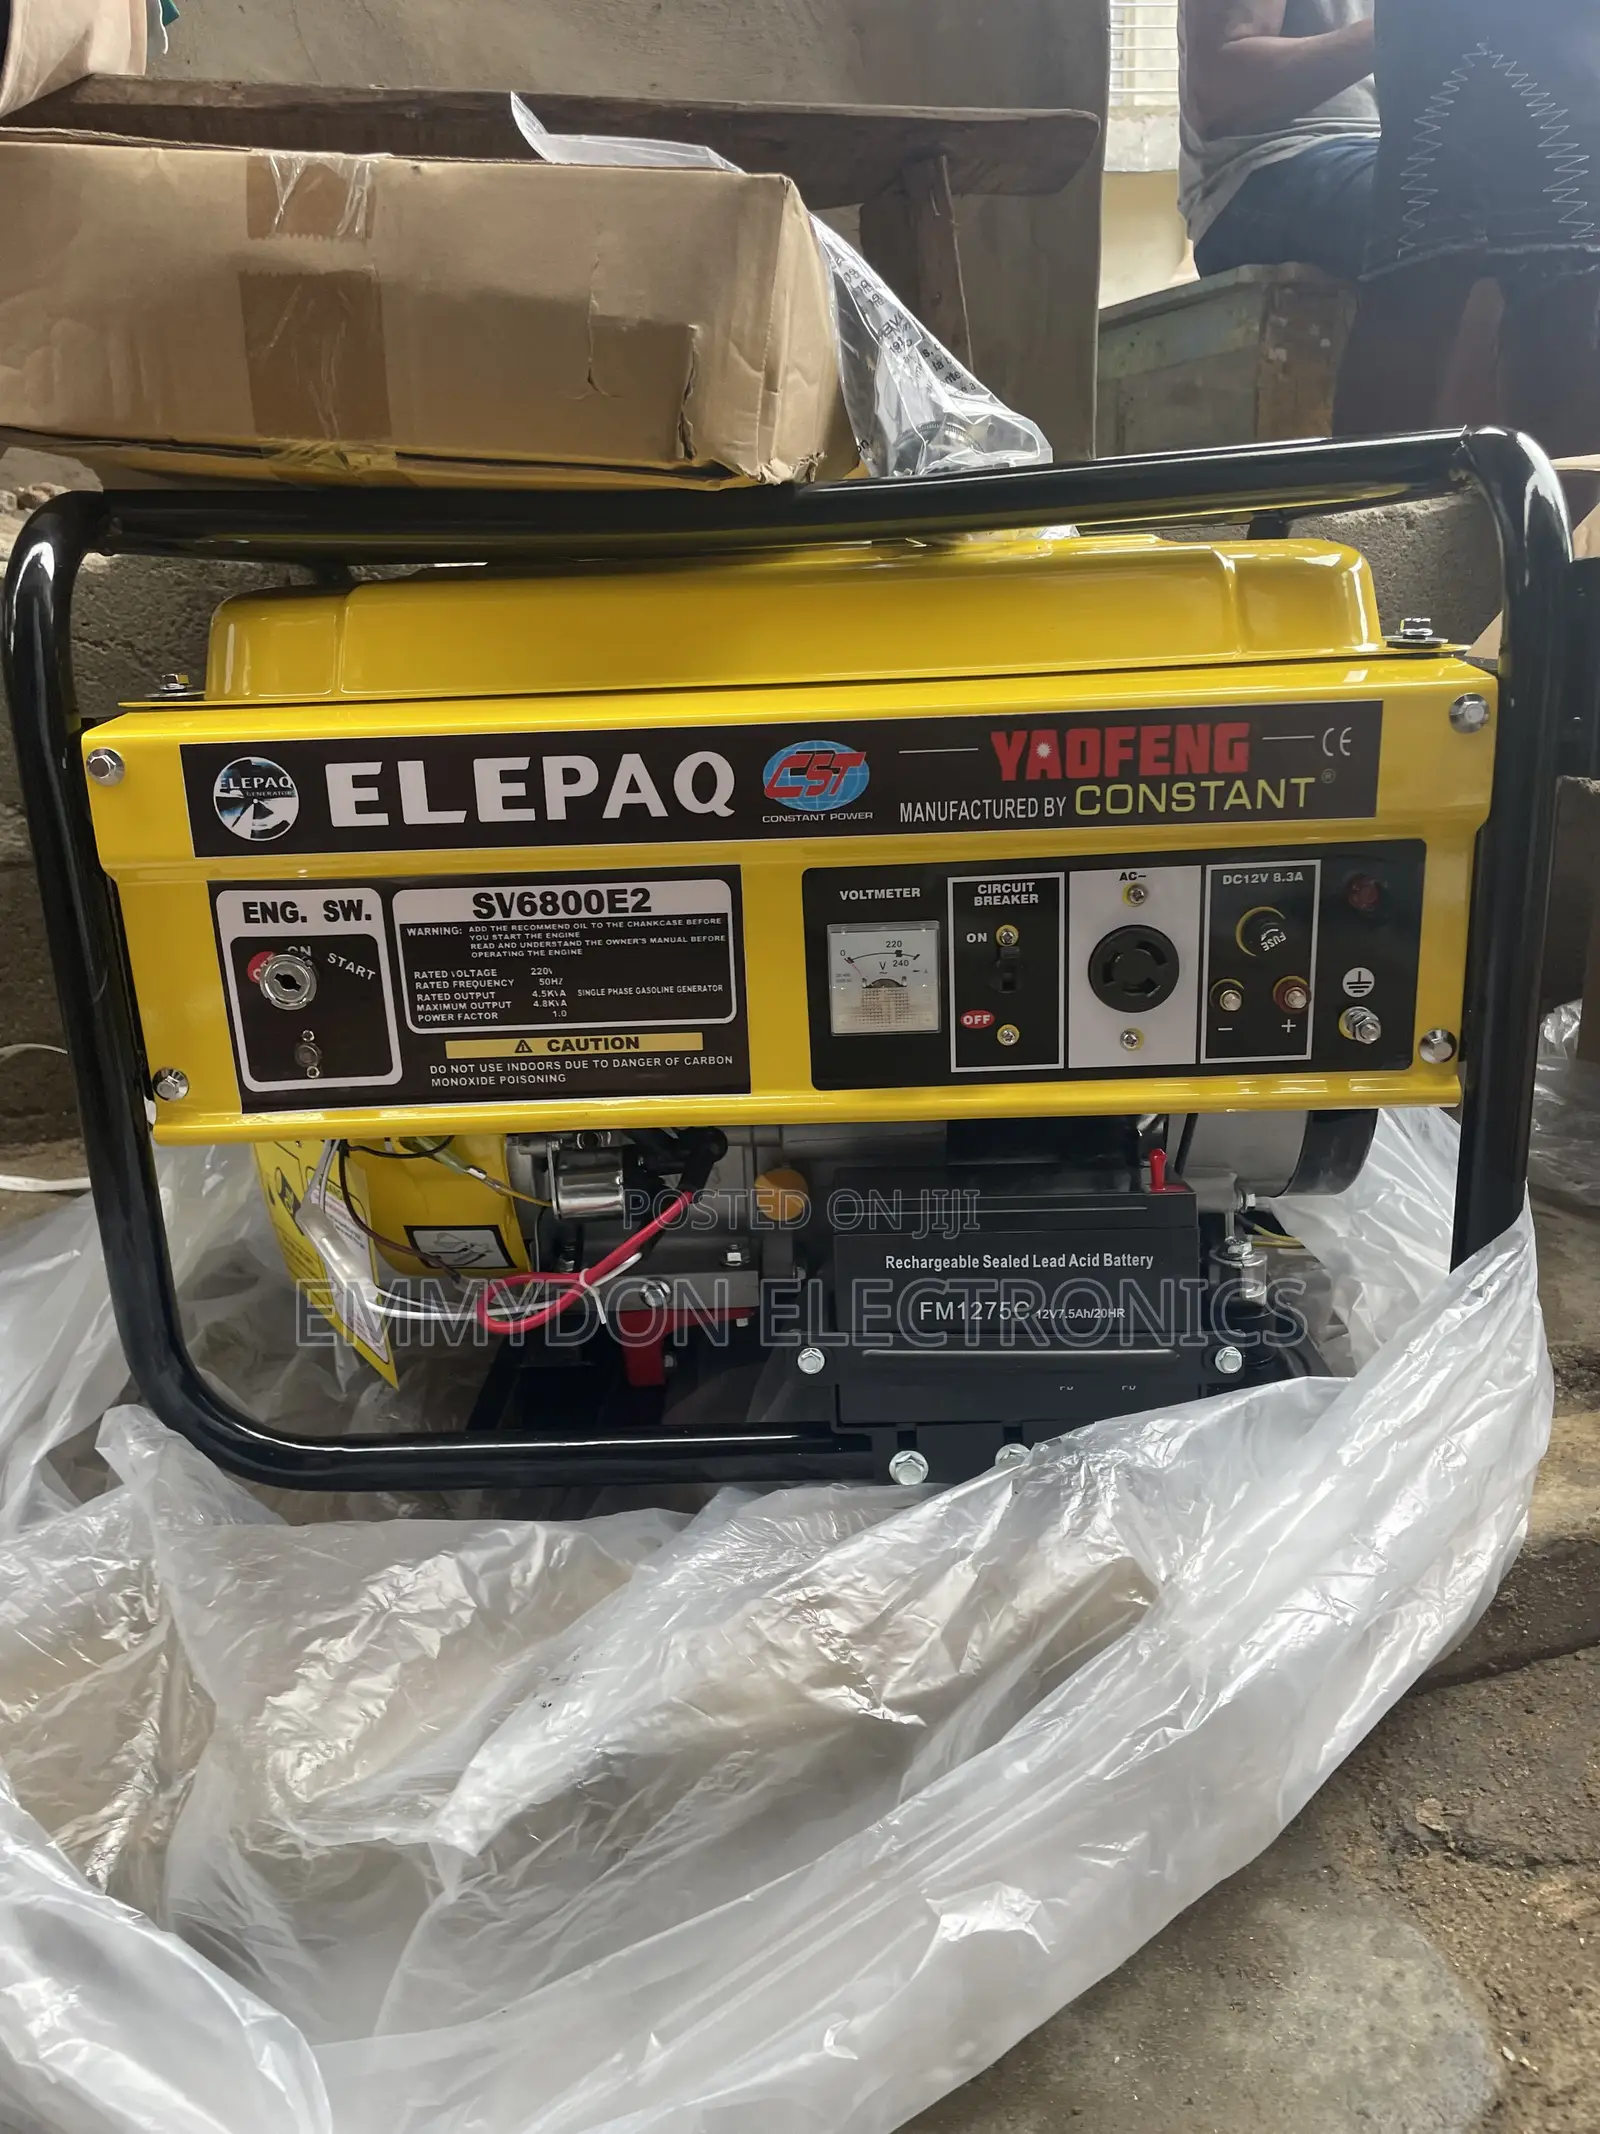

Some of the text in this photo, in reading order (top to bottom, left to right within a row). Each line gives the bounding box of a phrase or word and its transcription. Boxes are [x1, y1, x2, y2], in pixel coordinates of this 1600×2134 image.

[990, 722, 1250, 781] YAOFENG
[764, 751, 867, 799] CST
[220, 776, 292, 789] ELEPAQ
[325, 751, 735, 827] ELEPAQ
[900, 798, 1038, 823] MANUFACTURED
[1044, 796, 1067, 817] BY
[1075, 777, 1315, 816] CONSTANT
[762, 812, 873, 823] CONSTANT POWER
[1222, 871, 1304, 885] DC12V 8.3A
[839, 887, 921, 901] VOLTMETER
[977, 882, 1036, 895] CIRCUIT
[472, 888, 652, 920] SV6800E2
[974, 893, 1039, 907] BREAKER
[242, 899, 372, 924] ENG. SW.
[406, 925, 463, 937] WARNING:
[469, 925, 488, 933] ADD
[511, 923, 570, 932] RECOMMEND
[574, 922, 588, 930] OIL
[627, 919, 684, 928] CHANKCASE
[686, 917, 722, 926] BEFORE
[469, 931, 581, 942] YOU START THE ENGINE
[470, 942, 495, 950] READ
[498, 941, 517, 949] AND
[519, 940, 582, 948] UNDERSTAND
[585, 939, 603, 947] THE
[650, 936, 688, 944] MANUAL
[691, 934, 726, 943] BEFORE
[966, 932, 988, 943] ON
[1260, 931, 1287, 952] FUSE
[885, 940, 903, 948] 220
[471, 948, 583, 959] OPERATING THE ENGINE
[840, 949, 846, 957] 0
[327, 952, 376, 980] START
[879, 961, 887, 971] V
[892, 960, 910, 968] 240
[414, 970, 449, 980] RATED
[415, 977, 564, 990] RATED FREQUENCY 50HZ
[577, 984, 724, 997] SINGLE PHASE GASOLINE GENERATOR
[416, 992, 451, 1002] RATED
[453, 991, 496, 1000] OUTPUT
[416, 1002, 468, 1012] MAXIMUM
[470, 1001, 513, 1010] OUTPUT
[418, 1010, 568, 1022] POWER FACTOR 1.0
[963, 1014, 991, 1025] OFF
[547, 1036, 640, 1052] CAUTION
[430, 1055, 733, 1075] DO NOT USE INDOORS DUE TO DANGER OF CARBON
[431, 1073, 566, 1087] MONOXIDE POISONING
[885, 1253, 1154, 1272] Rechargeable Sealed Lead Acid Battery
[920, 1301, 1126, 1321] FM1275C 12V7.5Ah/20HR
